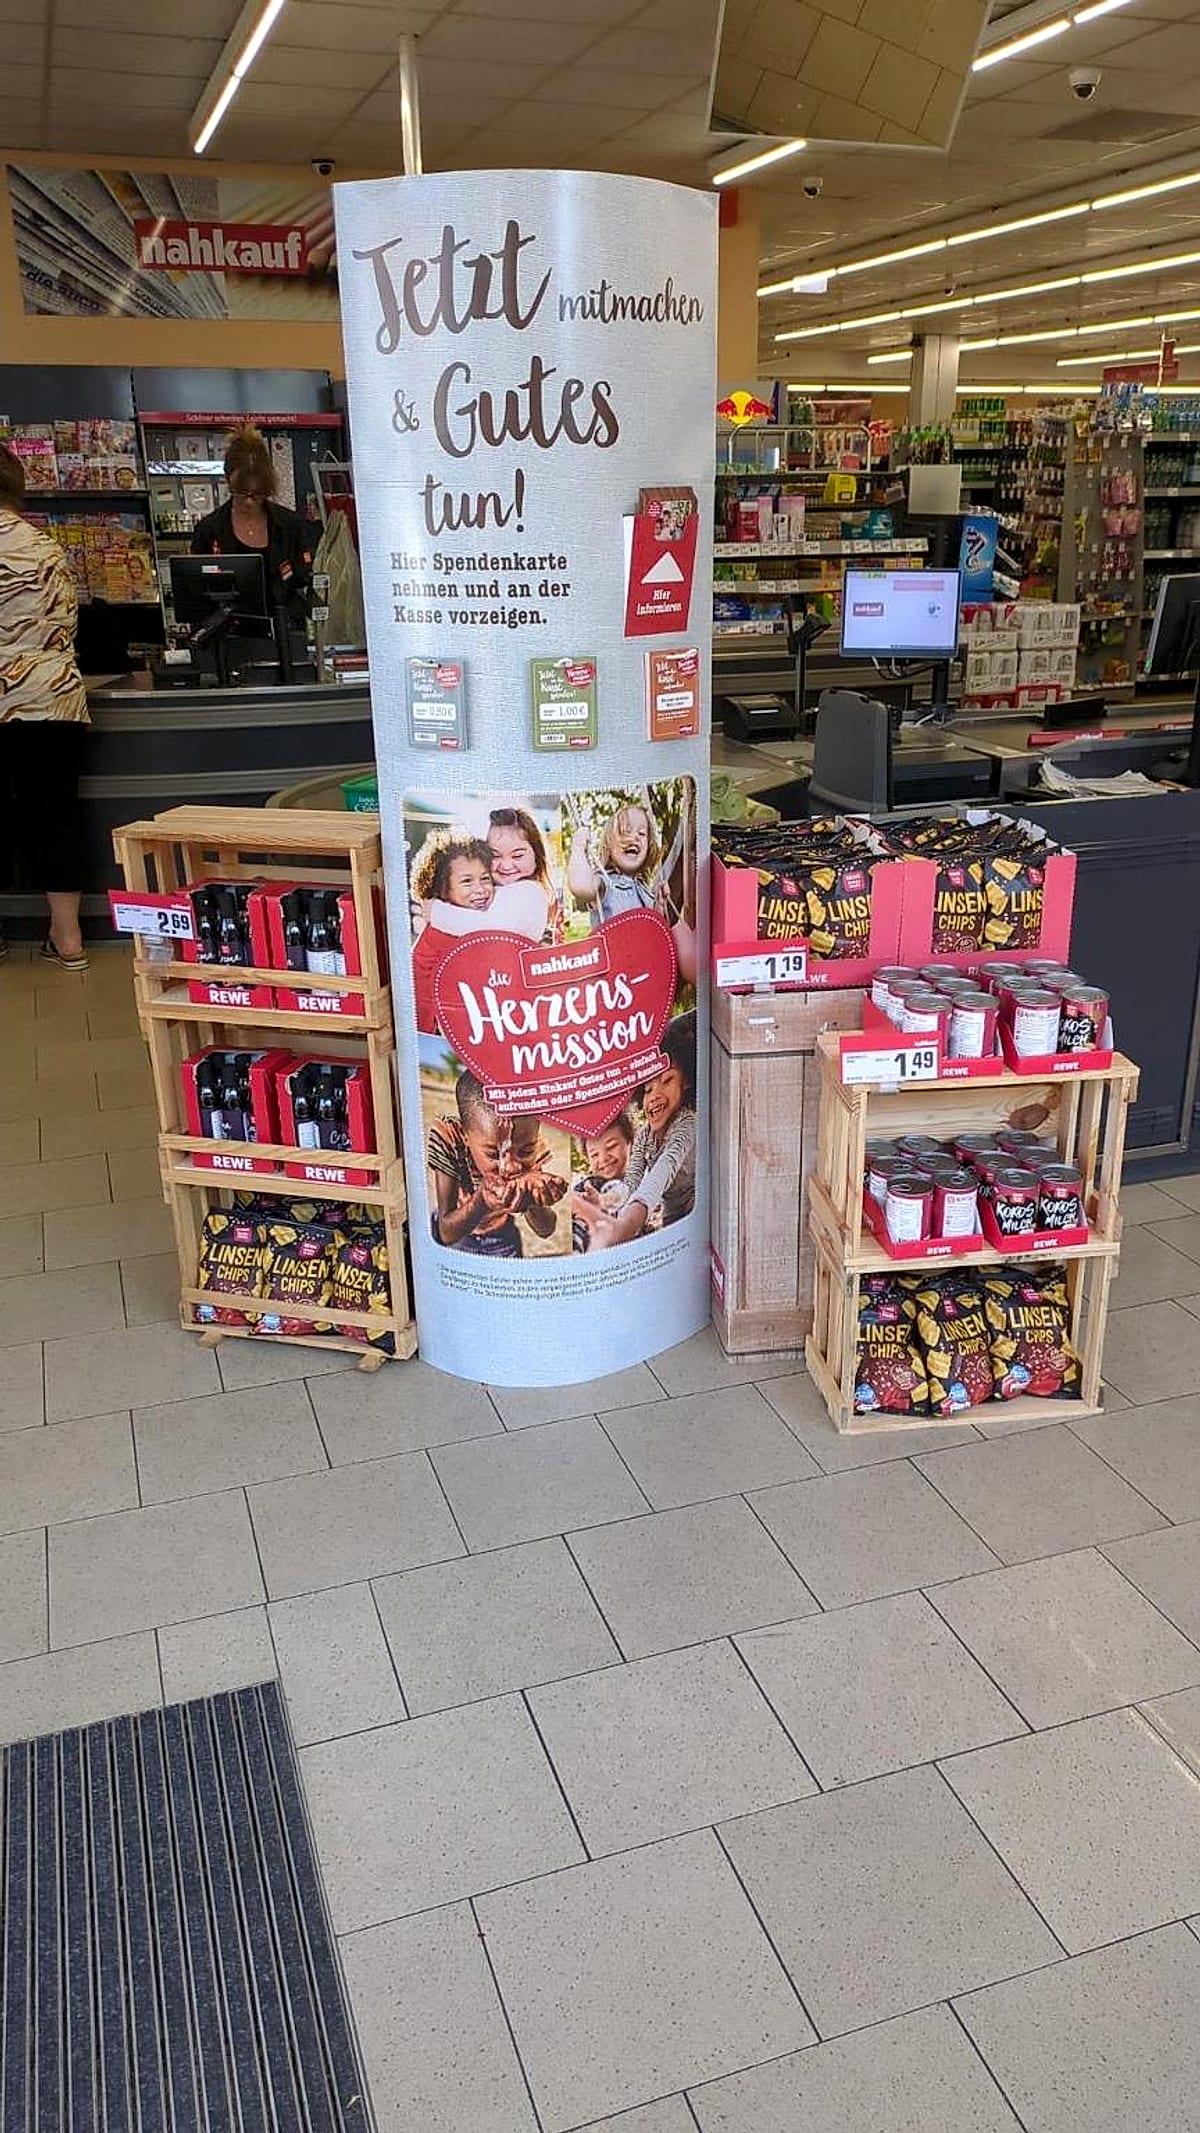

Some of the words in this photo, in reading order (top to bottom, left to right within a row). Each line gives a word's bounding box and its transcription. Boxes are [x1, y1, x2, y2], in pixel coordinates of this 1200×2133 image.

[141, 227, 302, 269] nahkauf
[352, 219, 551, 355] Jetzt
[558, 277, 704, 326] mitmachen
[392, 389, 420, 434] &
[433, 355, 619, 459] Gutes
[418, 468, 525, 537] tun!
[391, 552, 427, 570] Hier
[432, 552, 568, 575] Spendenkarte
[392, 580, 458, 597] nehmen
[465, 580, 500, 598] und
[507, 583, 532, 598] an
[538, 578, 571, 598] der
[652, 589, 672, 600] Hier
[393, 606, 443, 625] Kasse
[448, 606, 548, 629] vorzeigen.
[758, 896, 808, 924] LINSE
[934, 891, 988, 914] INSEN
[1011, 890, 1043, 913] LINS
[157, 911, 190, 935] 2.69
[938, 914, 976, 931] CHIPS
[530, 946, 600, 977] nahkauf
[764, 955, 803, 979] 1.19
[488, 968, 512, 988] die
[209, 989, 251, 1005] REWE
[298, 996, 342, 1012] REWE
[458, 972, 650, 1046] Herzens-
[511, 1010, 655, 1075] mission
[894, 1051, 934, 1077] 1.49
[942, 1067, 969, 1076] REWE
[1053, 1061, 1080, 1072] REWE
[488, 1089, 506, 1100] Mit
[507, 1087, 538, 1101] jedem
[539, 1081, 577, 1095] Einkauf
[578, 1074, 605, 1086] Gutes
[606, 1068, 622, 1080] tun
[629, 1052, 658, 1071] einfach
[498, 1098, 549, 1112] aufrunden
[551, 1093, 574, 1106] oder
[575, 1073, 637, 1101] Spendenkarte
[212, 1155, 254, 1170] REWE
[305, 1166, 346, 1182] REWE
[996, 1201, 1035, 1221] KOKOS
[1041, 1195, 1078, 1216] KOKOS
[1002, 1216, 1033, 1234] MILCH
[1045, 1211, 1077, 1228] MILCH
[926, 1245, 953, 1255] REWE
[1032, 1238, 1058, 1249] REWE
[209, 1243, 265, 1268] LINSEN
[216, 1264, 250, 1282] CHIPS
[272, 1255, 330, 1279] LINSEN
[280, 1277, 316, 1295] CHIPS
[940, 1311, 988, 1342] LINSEN
[1009, 1306, 1064, 1328] LINSEN
[958, 1337, 988, 1356] CHIPS
[1025, 1329, 1055, 1344] CHIPS
